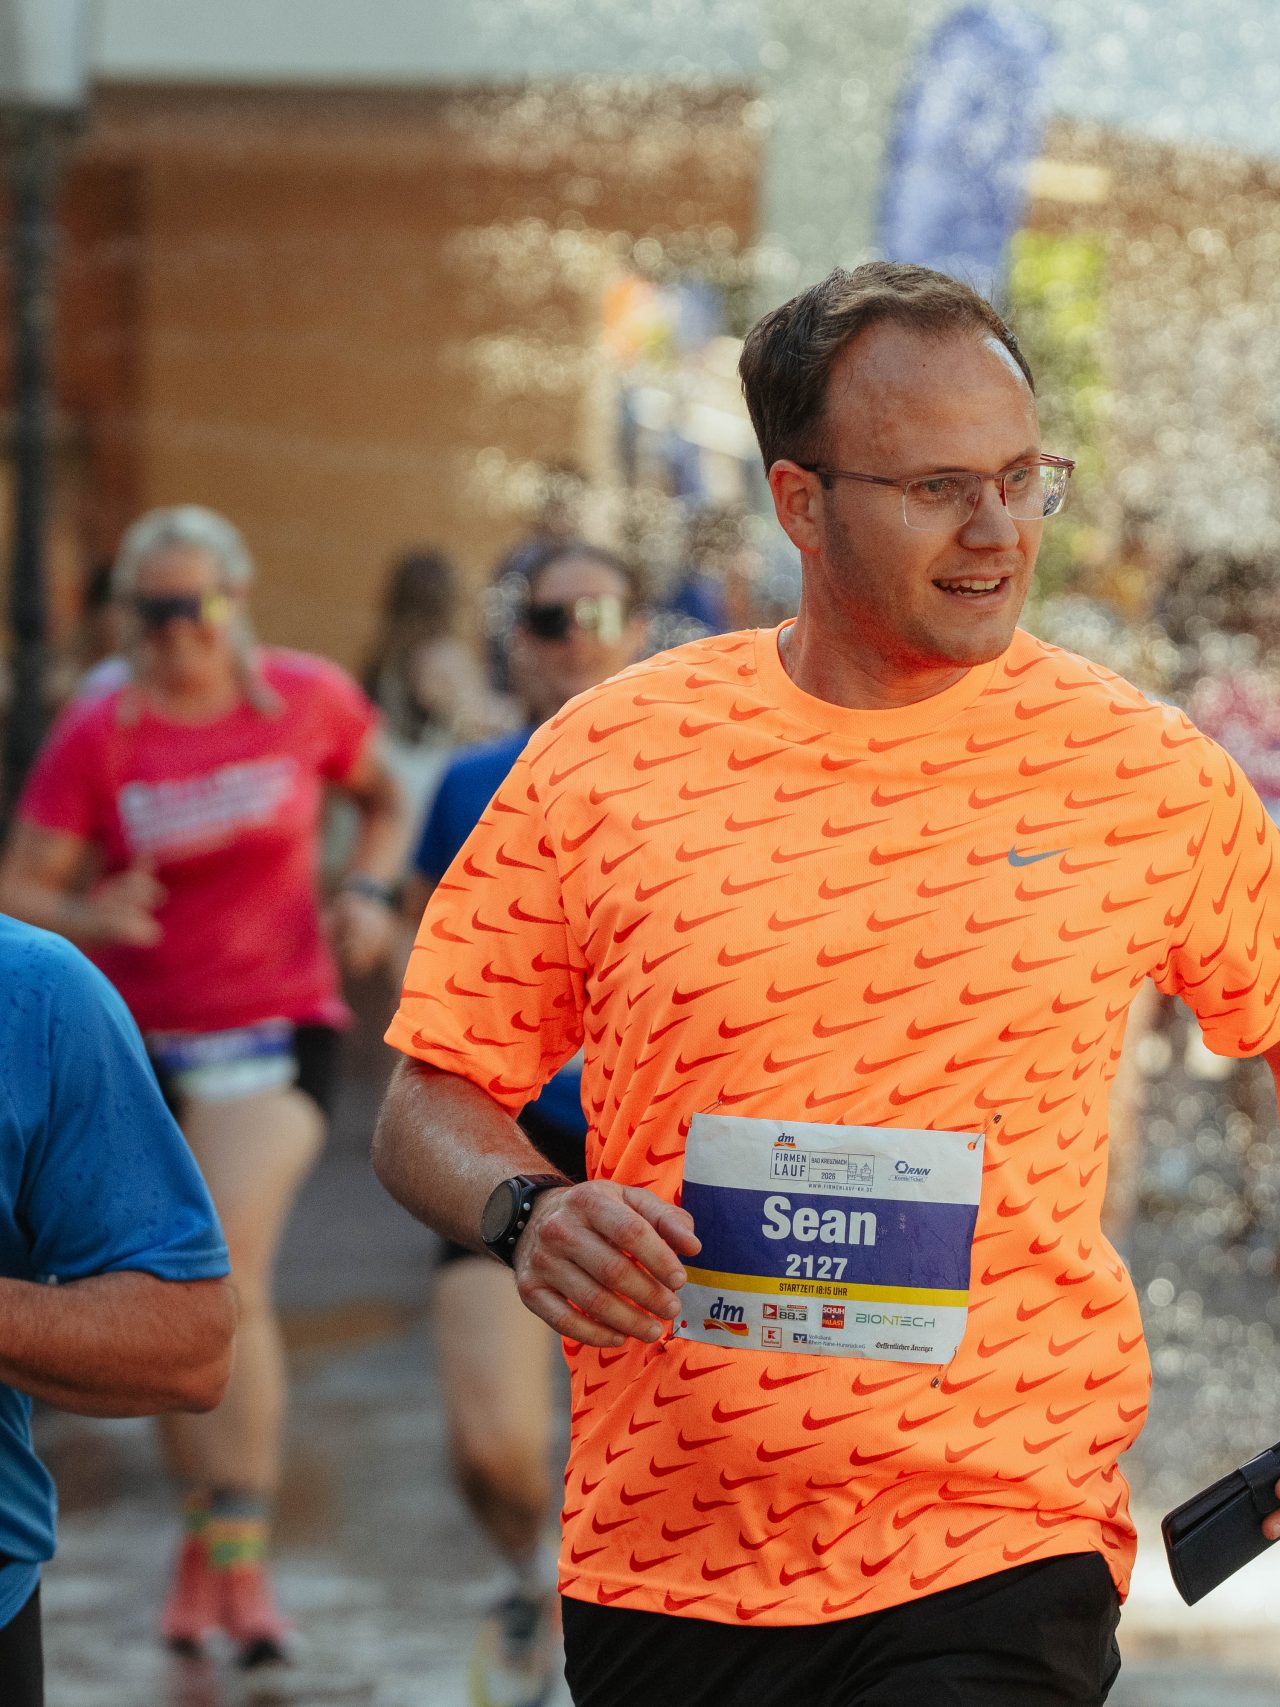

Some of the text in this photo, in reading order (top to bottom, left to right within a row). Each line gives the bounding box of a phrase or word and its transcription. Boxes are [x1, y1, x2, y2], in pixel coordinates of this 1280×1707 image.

[778, 1133, 794, 1142] dm
[775, 1153, 807, 1163] FIRMEN
[774, 1164, 806, 1178] LAUF
[761, 1195, 877, 1246] Sean
[785, 1253, 848, 1280] 2127
[779, 1282, 848, 1297] STARTZEIT 18:15 UHR
[709, 1296, 745, 1323] dm
[779, 1311, 807, 1321] 88.3
[822, 1306, 845, 1315] SCHUH
[855, 1313, 936, 1329] BIONTECH
